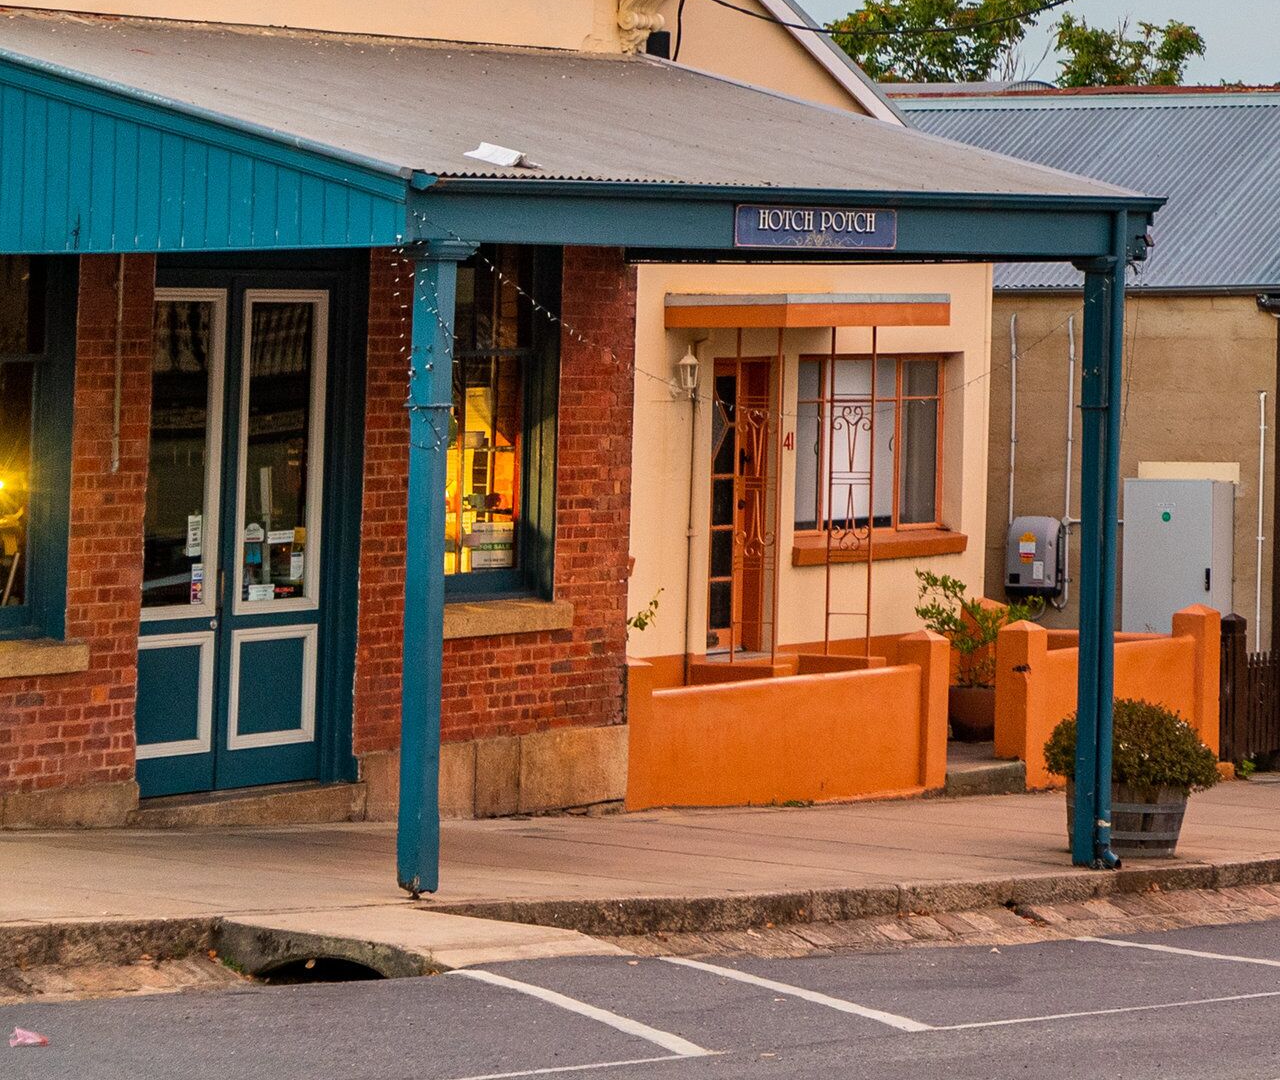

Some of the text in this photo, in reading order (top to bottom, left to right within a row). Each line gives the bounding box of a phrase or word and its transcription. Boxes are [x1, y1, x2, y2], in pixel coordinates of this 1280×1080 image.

[758, 209, 876, 232] HOTCH POTCH
[783, 431, 794, 451] 41
